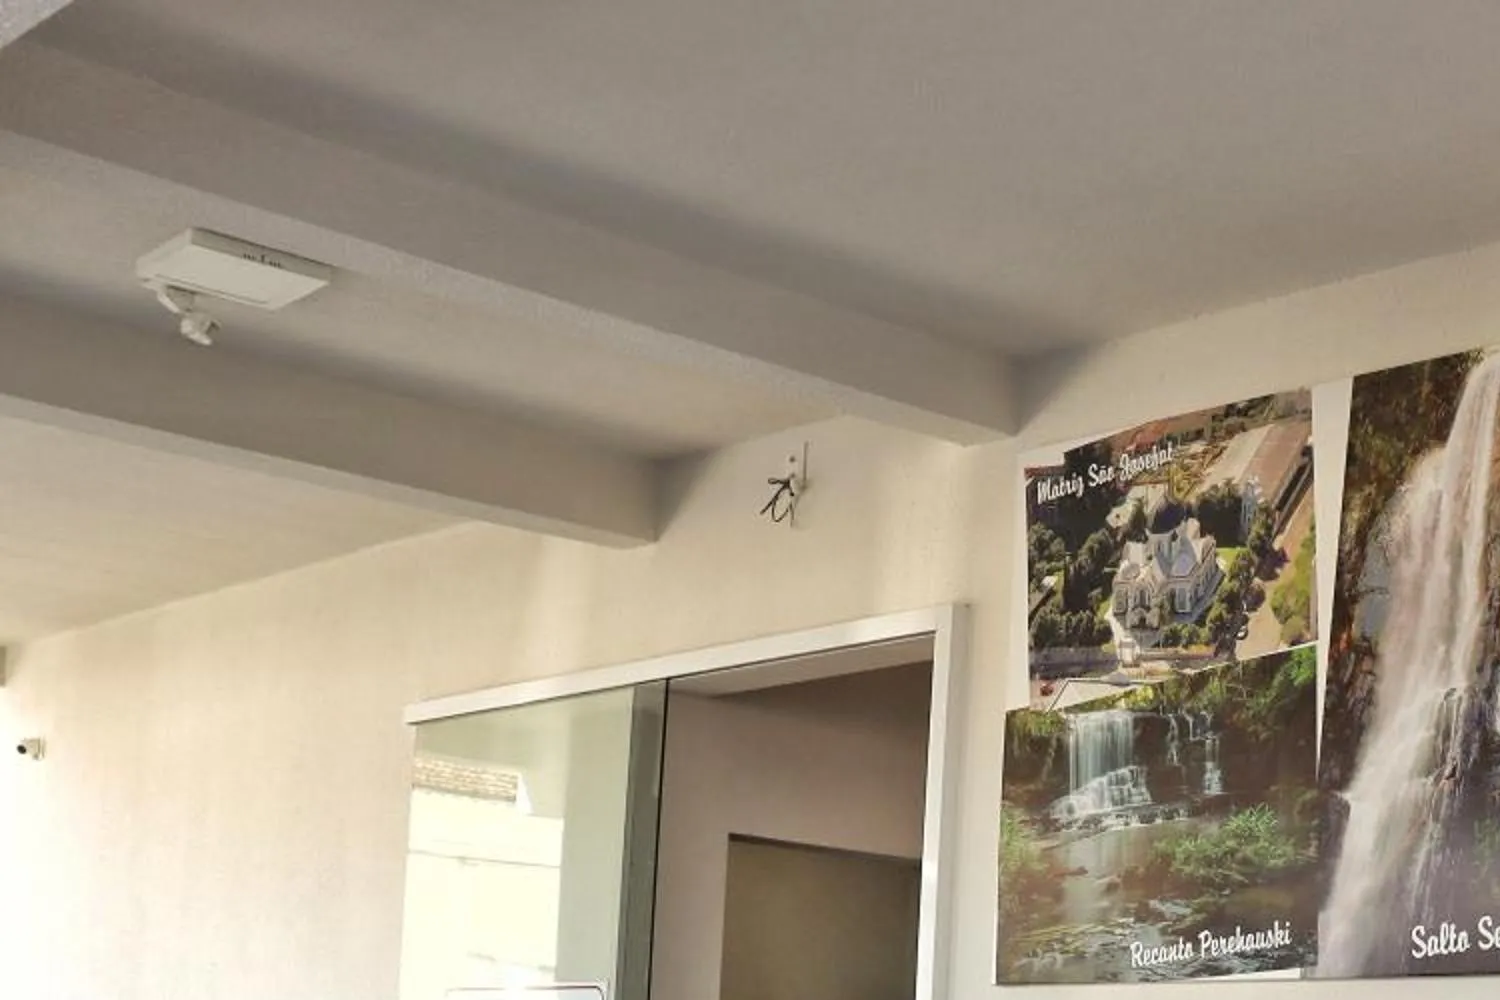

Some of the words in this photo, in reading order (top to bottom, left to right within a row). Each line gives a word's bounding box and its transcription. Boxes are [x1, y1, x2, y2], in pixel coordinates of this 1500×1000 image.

[1037, 472, 1084, 505] Matriz
[1088, 463, 1115, 486] São
[1130, 936, 1194, 968] Recanto
[1411, 922, 1471, 959] Salto
